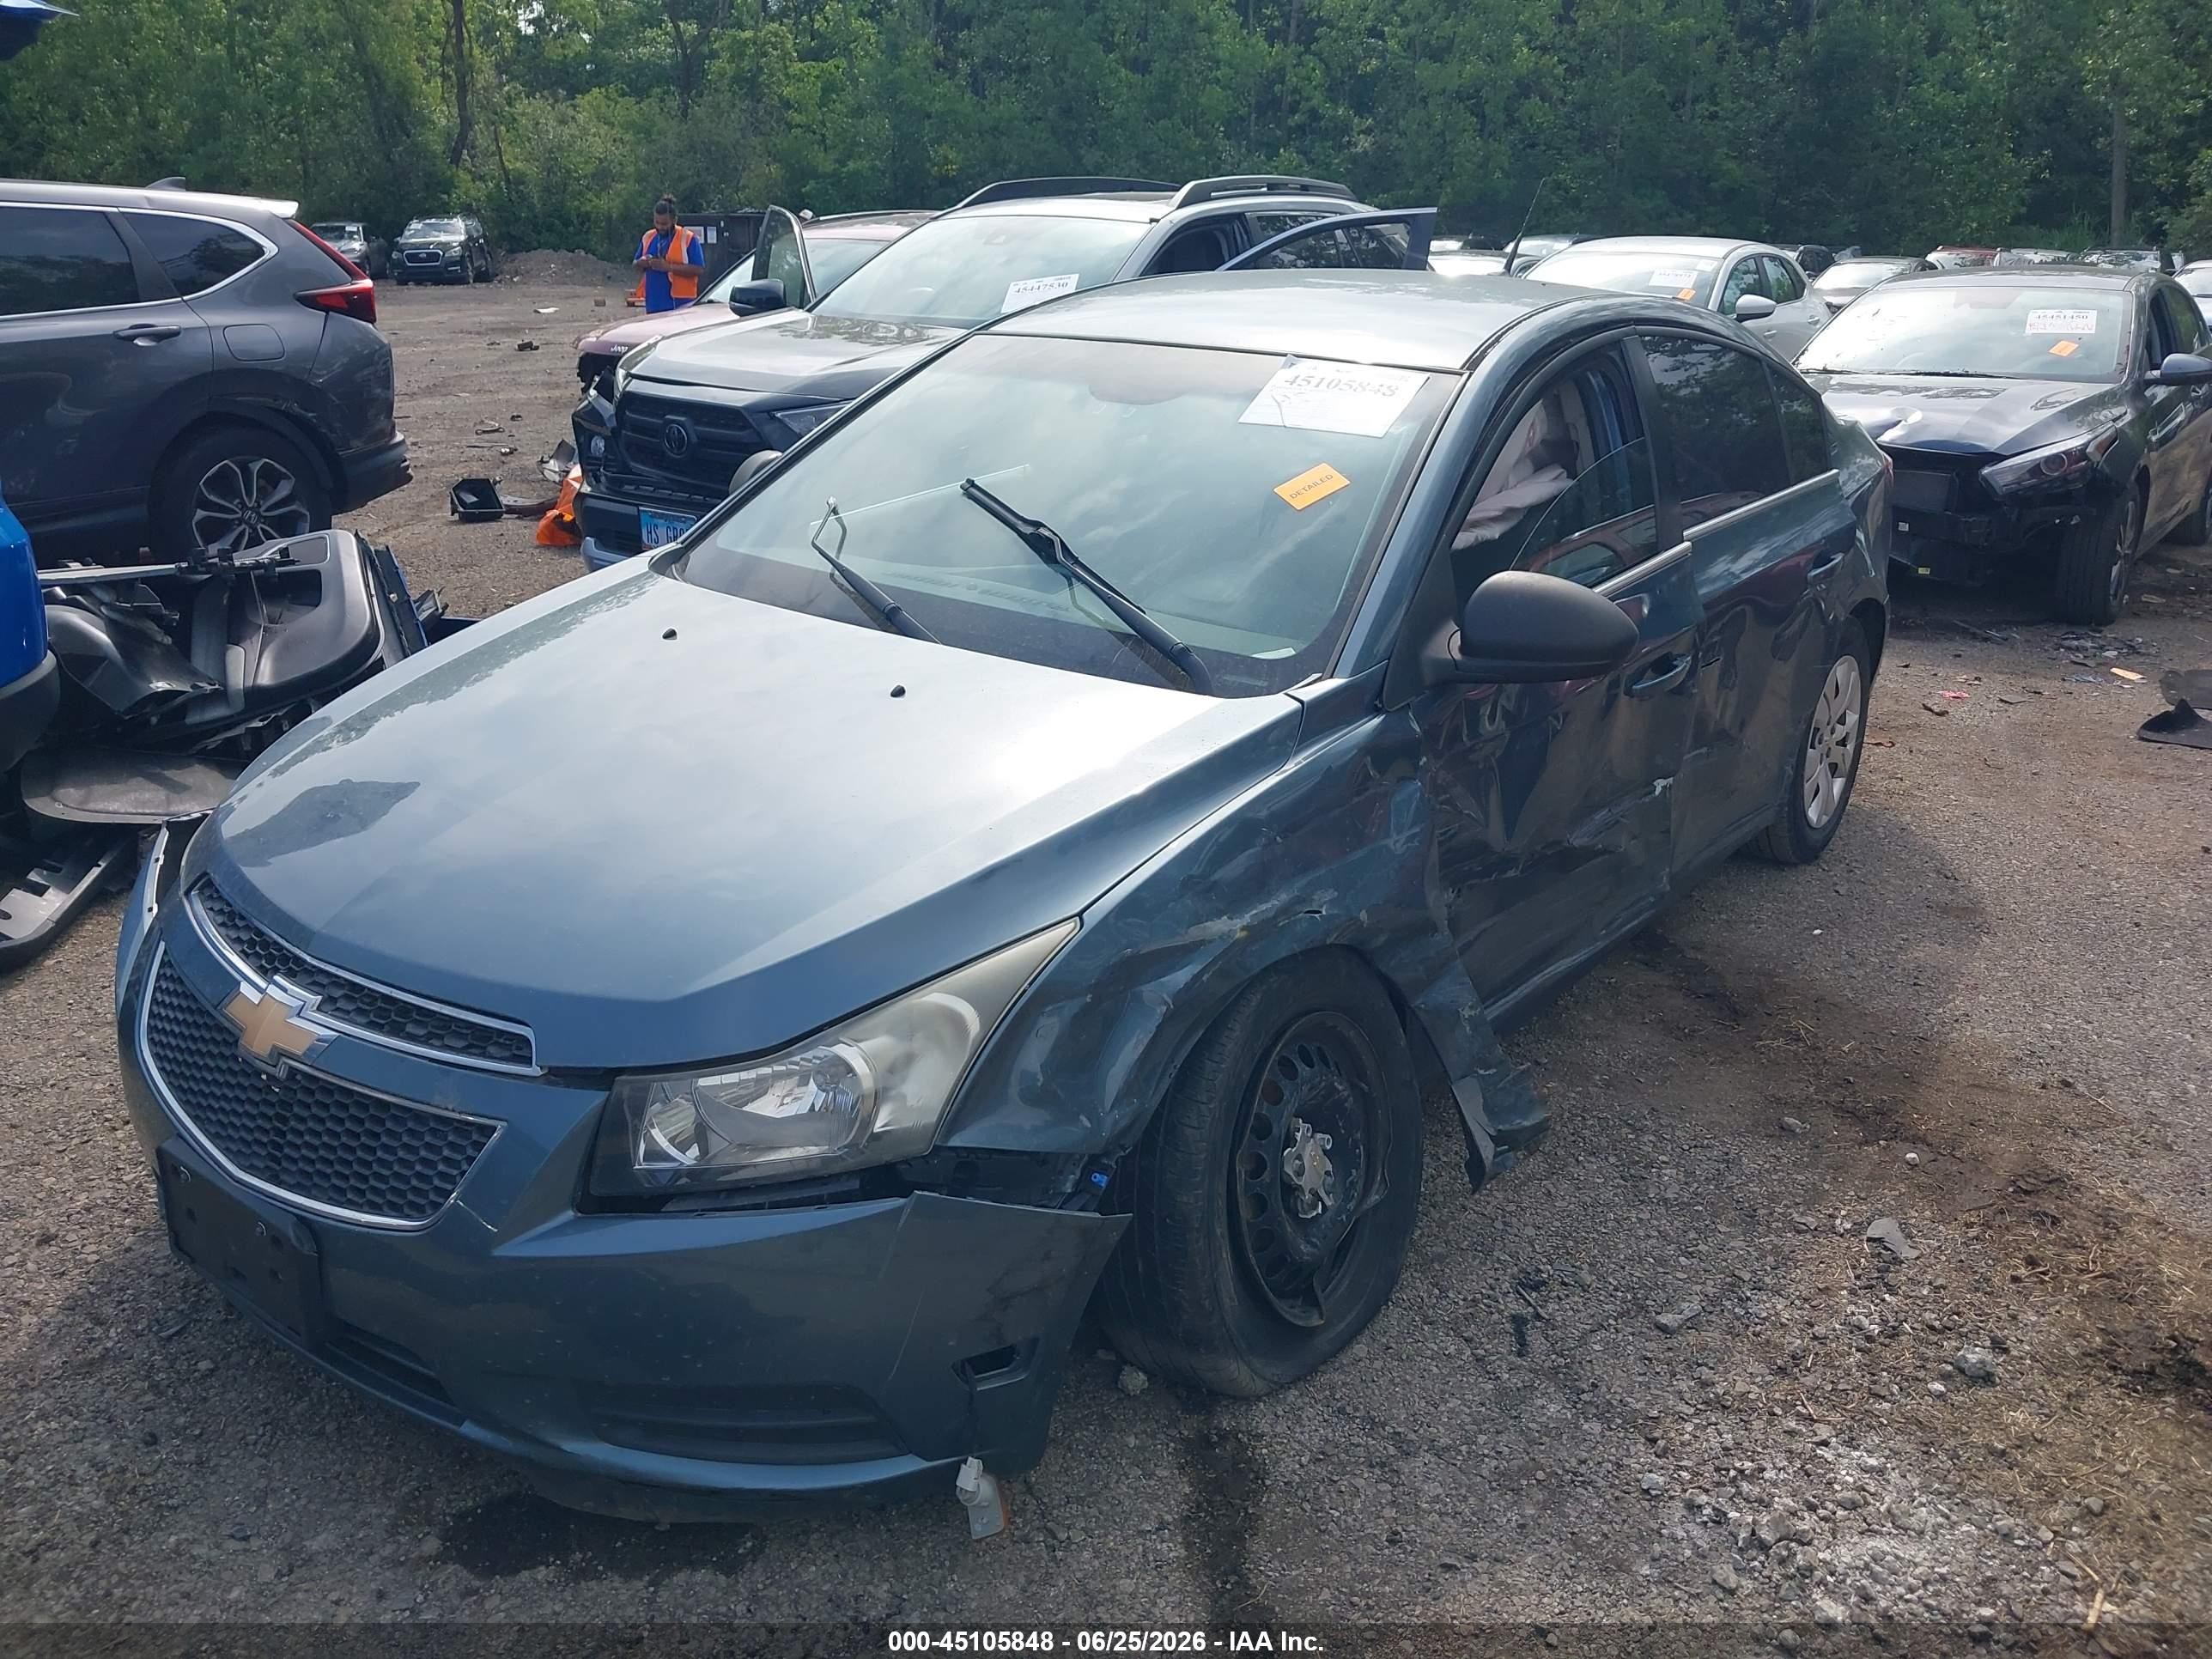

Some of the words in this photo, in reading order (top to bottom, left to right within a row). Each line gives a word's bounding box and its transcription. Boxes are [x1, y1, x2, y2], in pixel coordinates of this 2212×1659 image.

[1285, 374, 1400, 397] 45105848
[1290, 474, 1334, 499] DETAILED
[647, 522, 659, 544] HS
